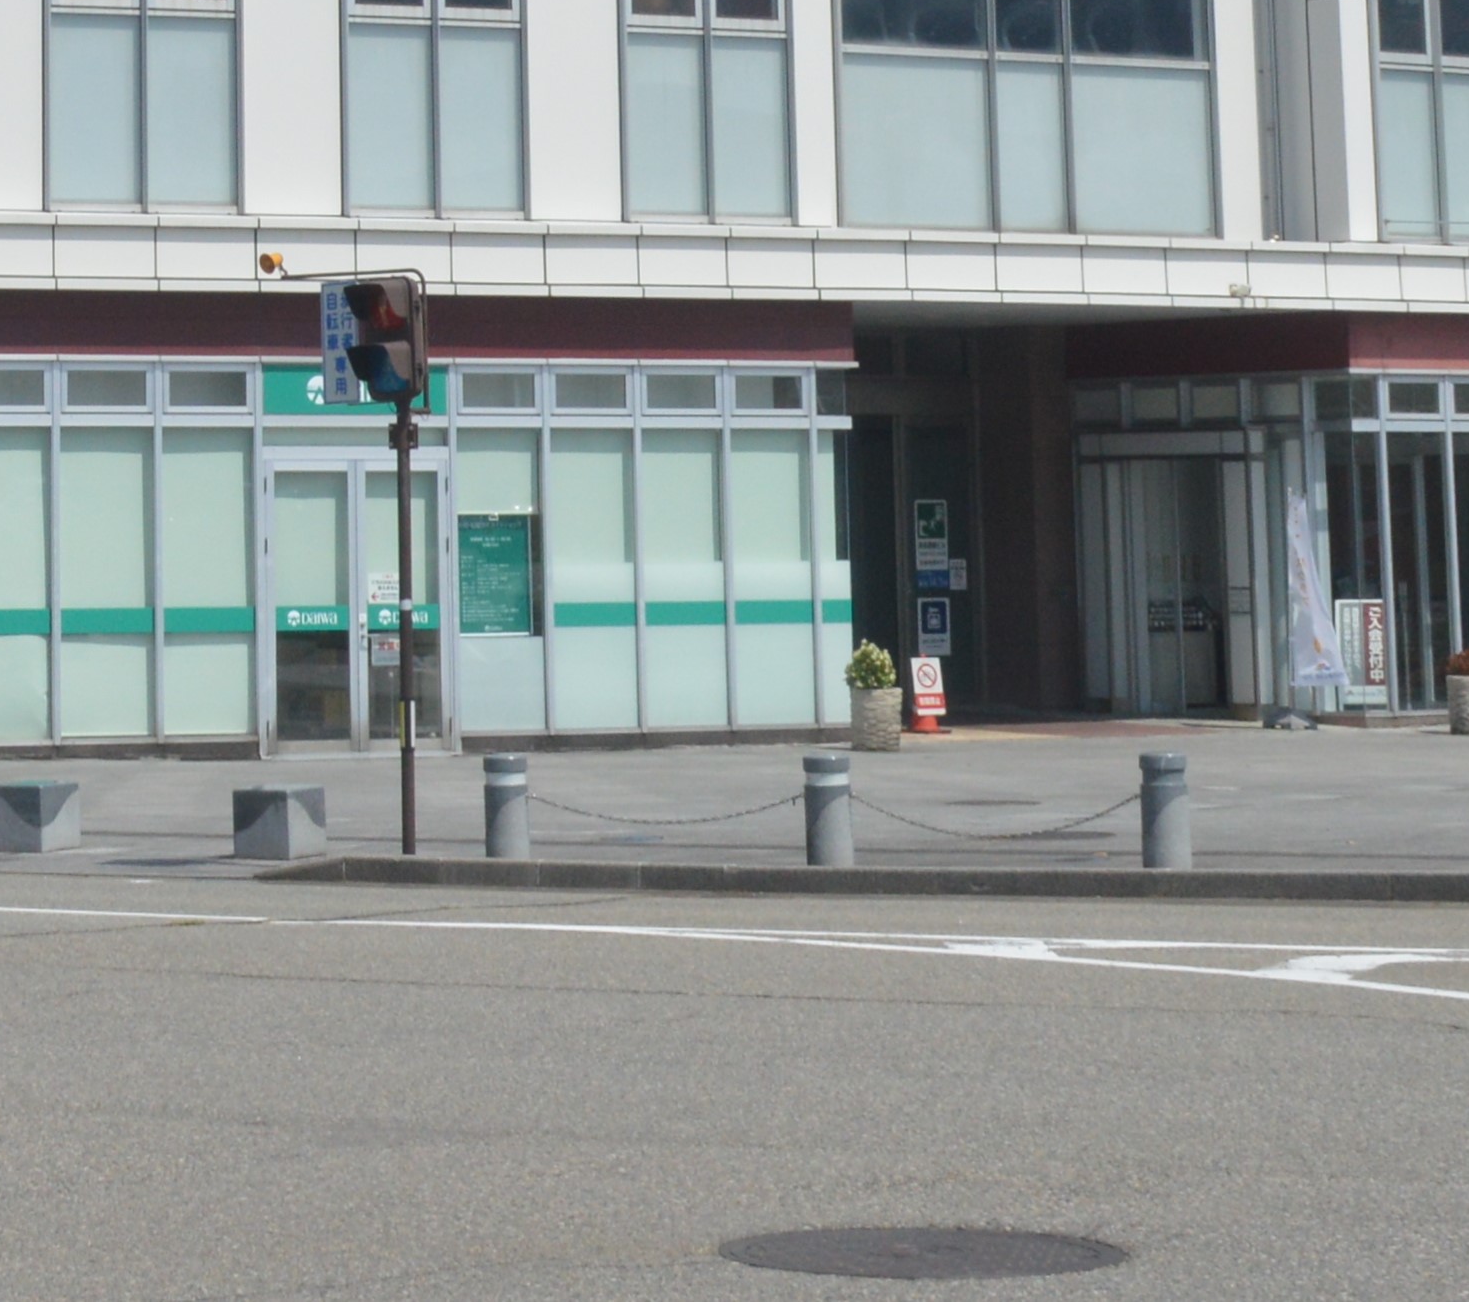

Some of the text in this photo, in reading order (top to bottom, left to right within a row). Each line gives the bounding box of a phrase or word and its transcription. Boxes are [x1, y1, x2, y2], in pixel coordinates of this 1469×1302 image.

[301, 610, 339, 626] Daiwa
[1367, 606, 1385, 683] ご入会受付中
